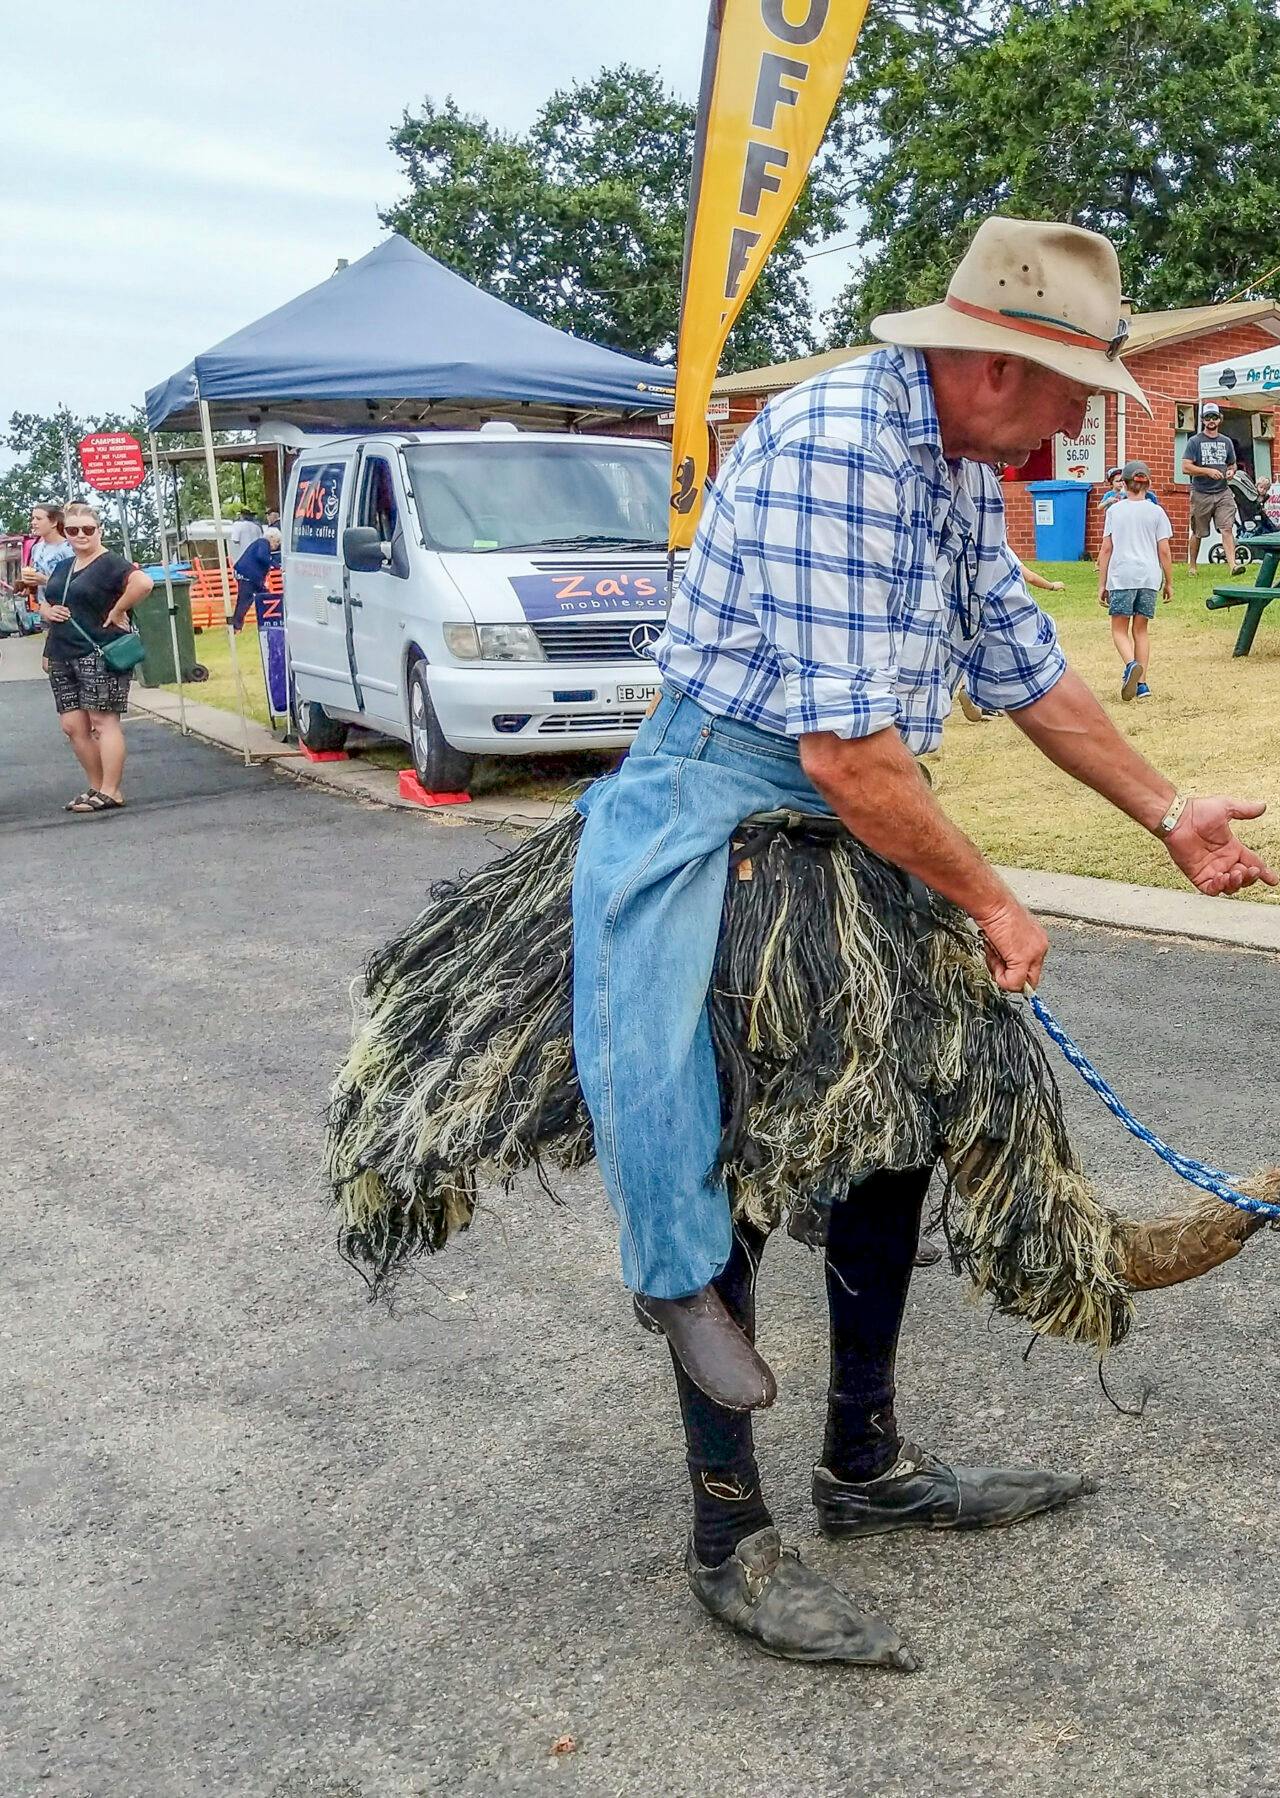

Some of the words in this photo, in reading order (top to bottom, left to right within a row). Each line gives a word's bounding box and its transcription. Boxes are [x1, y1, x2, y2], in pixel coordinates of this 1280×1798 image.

[1247, 368, 1260, 382] As
[1083, 417, 1099, 429] ING
[91, 437, 126, 445] CAMPERS
[1066, 449, 1090, 461] $6.50
[295, 480, 326, 520] Za's
[315, 526, 336, 539] coffee
[551, 574, 657, 599] Za's
[561, 599, 631, 611] mobile
